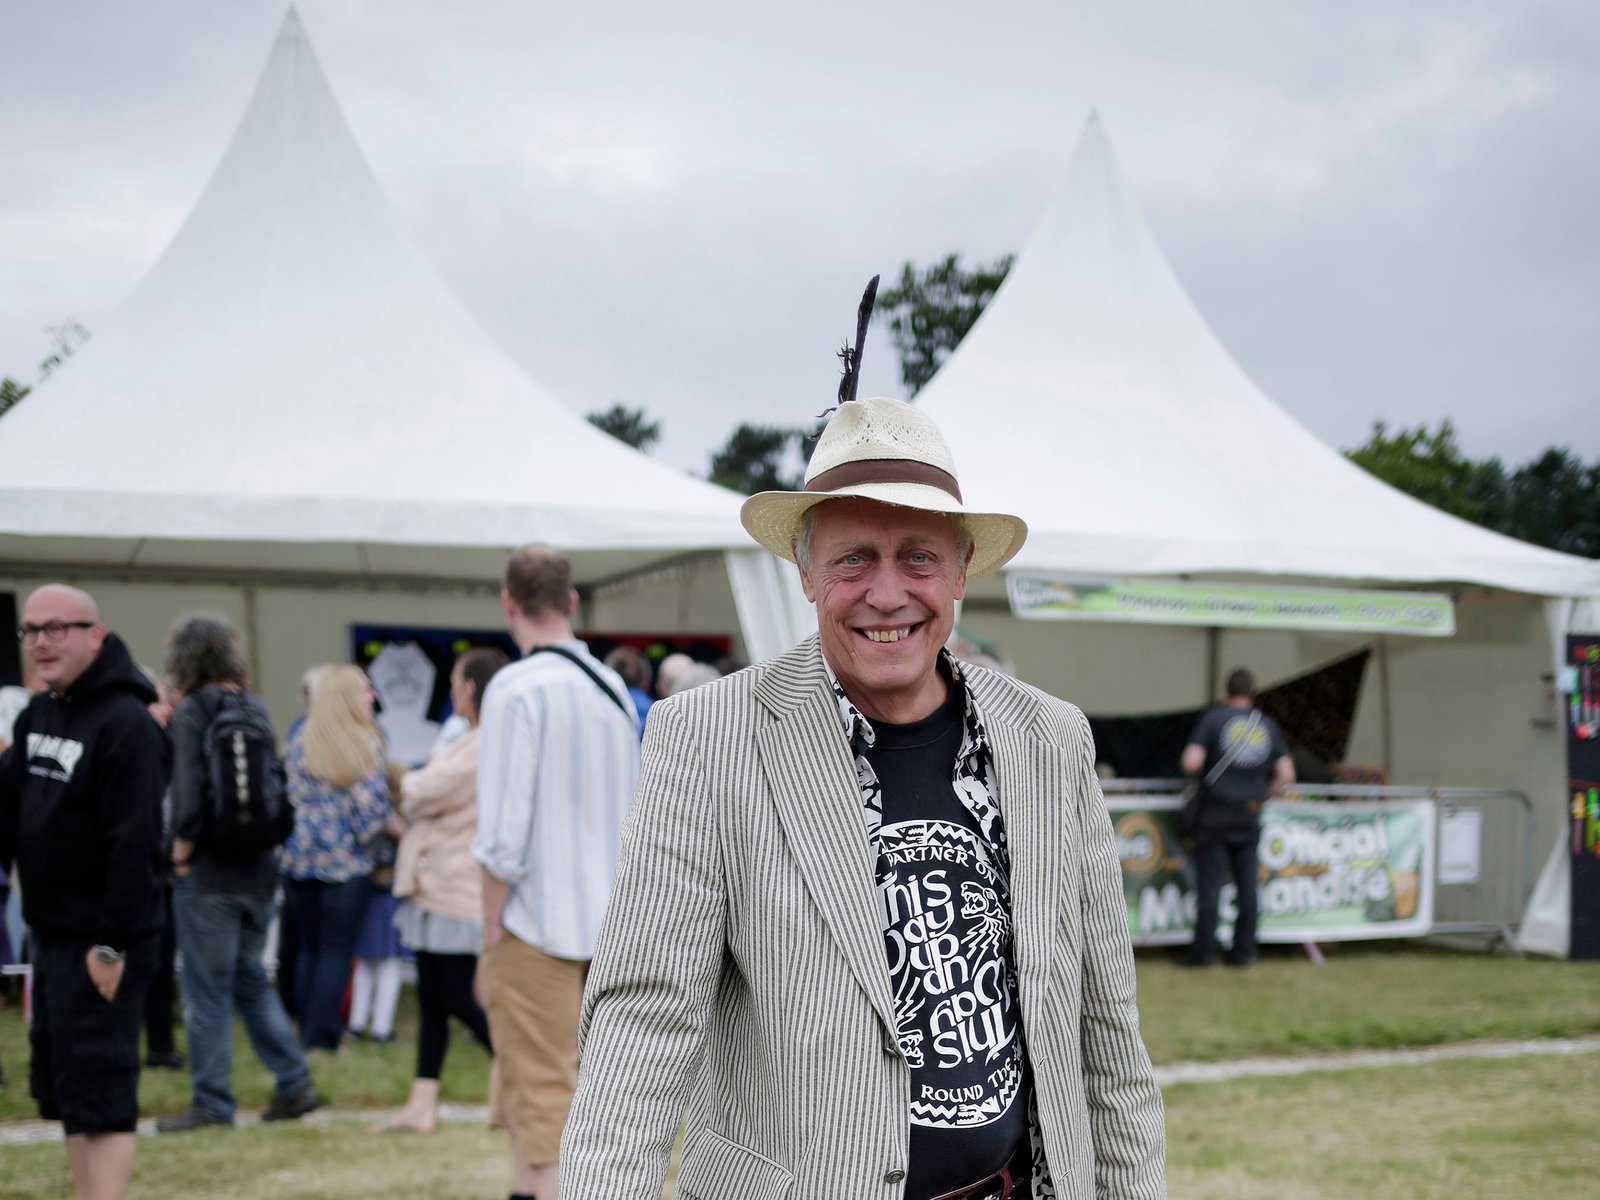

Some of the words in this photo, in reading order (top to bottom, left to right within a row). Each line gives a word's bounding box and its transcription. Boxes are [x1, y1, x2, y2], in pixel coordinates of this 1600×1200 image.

[886, 847, 969, 867] PARTNER
[976, 862, 996, 885] ON
[921, 1084, 984, 1102] ROUND
